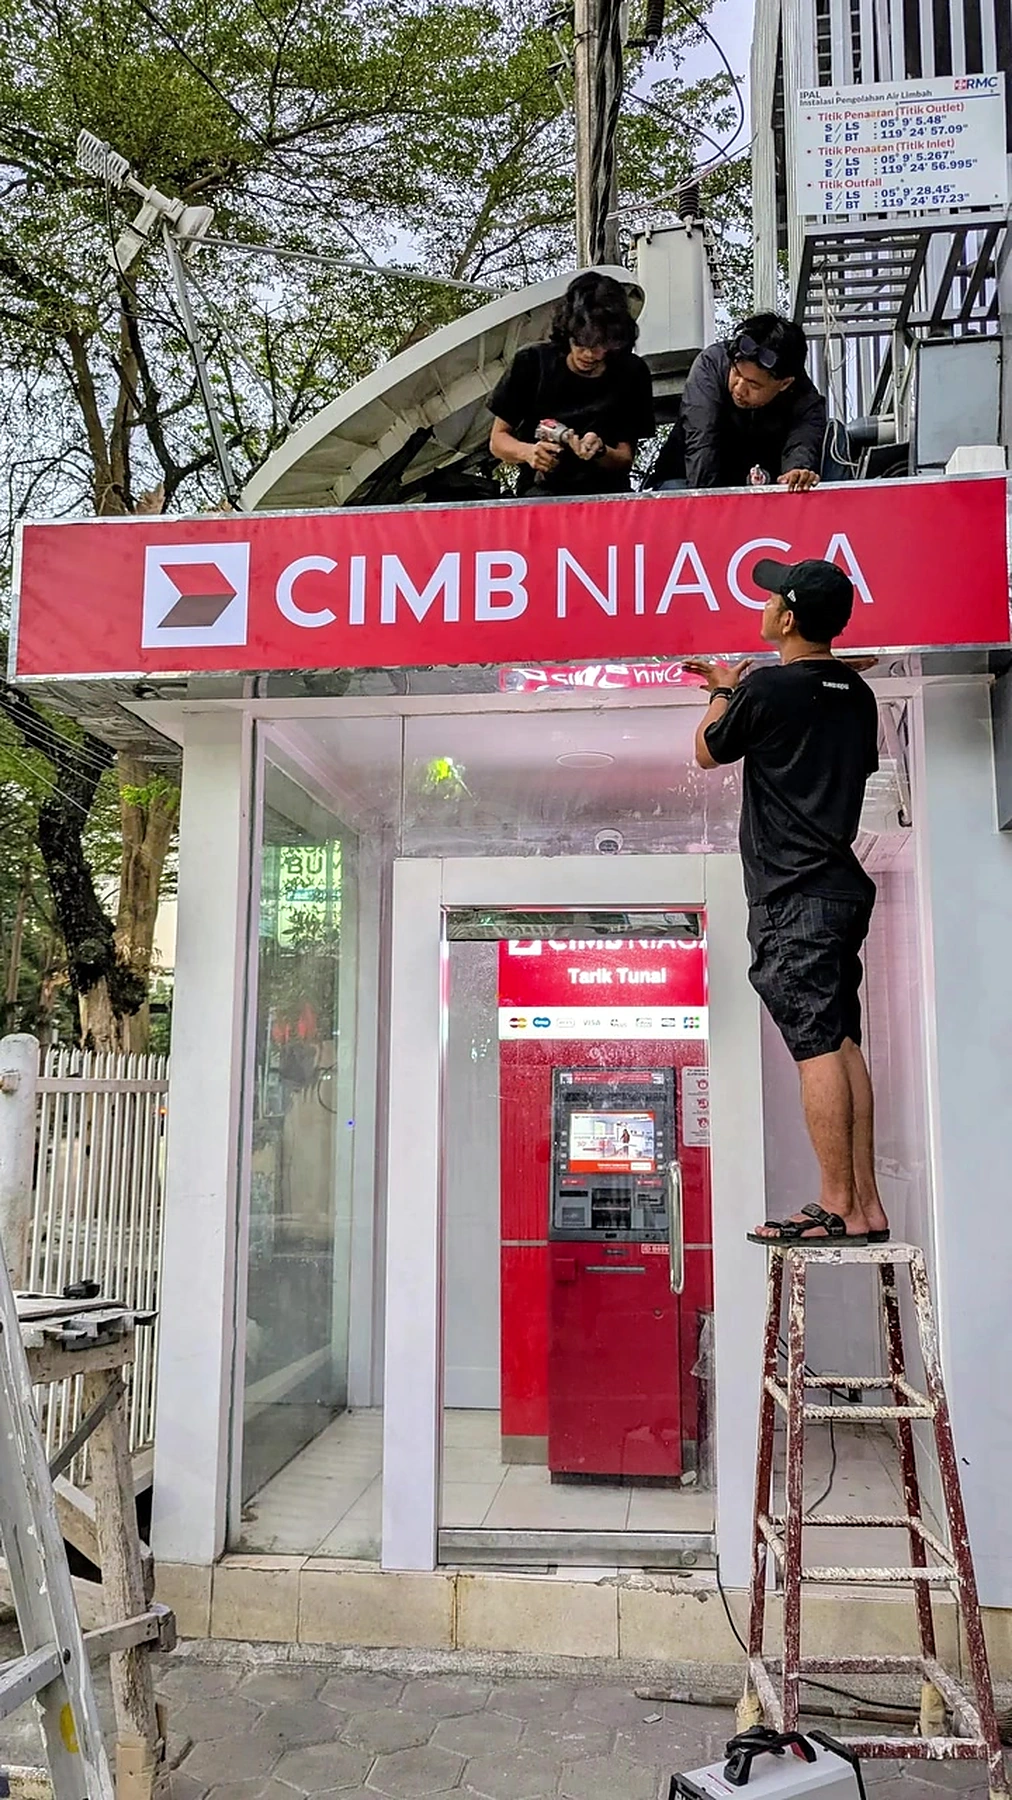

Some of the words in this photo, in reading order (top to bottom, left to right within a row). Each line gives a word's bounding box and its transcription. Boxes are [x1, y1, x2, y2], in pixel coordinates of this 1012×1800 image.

[967, 77, 998, 89] RMC
[800, 91, 821, 99] IPAL
[800, 96, 834, 106] Instalasi
[836, 94, 884, 104] Pengolahan
[901, 90, 932, 98] Limbah
[818, 112, 842, 121] Titik
[845, 108, 894, 119] Penaatan
[896, 107, 924, 119] (Titik
[926, 103, 964, 113] Outlet)
[825, 123, 832, 132] S
[845, 122, 860, 131] LS
[825, 134, 832, 143] E
[845, 133, 859, 141] BT
[818, 147, 842, 155] Titik
[845, 144, 894, 154] Penaatan
[896, 141, 924, 151] (Titik
[926, 138, 954, 148] Inlet)
[825, 159, 832, 167] S
[845, 158, 860, 166] LS
[825, 169, 832, 177] E
[845, 168, 859, 176] BT
[818, 180, 842, 189] Titik
[845, 178, 882, 188] Outfall
[825, 192, 832, 200] S
[846, 191, 860, 199] LS
[826, 202, 832, 210] E
[846, 201, 859, 209] BT
[275, 550, 529, 628] CIMB
[556, 532, 874, 618] NIAGA
[567, 968, 613, 984] Tarik
[616, 967, 667, 984] Tunai
